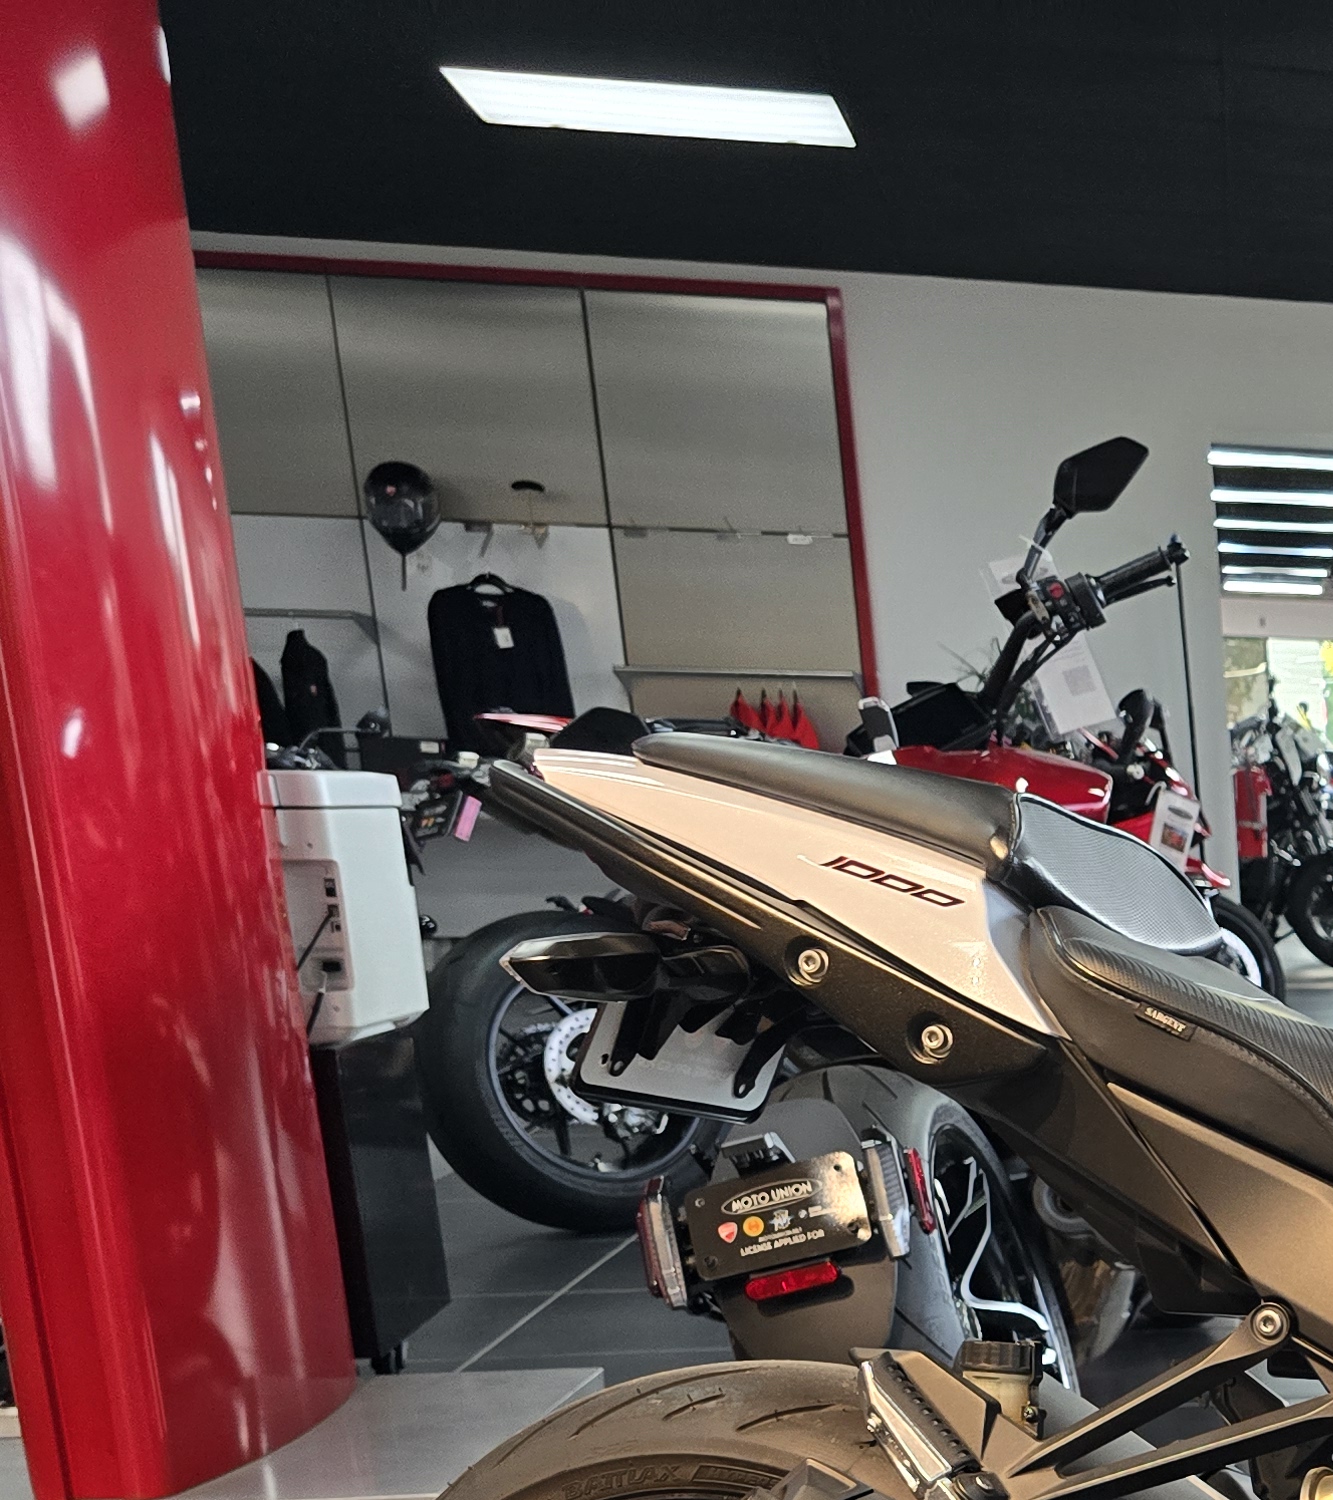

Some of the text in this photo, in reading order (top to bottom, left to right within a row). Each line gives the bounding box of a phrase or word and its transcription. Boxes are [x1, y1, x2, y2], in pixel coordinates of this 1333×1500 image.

[819, 855, 965, 907] 1000
[732, 1180, 813, 1212] MOTO UNION
[740, 1242, 772, 1257] LICENSE
[773, 1233, 806, 1249] APPLIED
